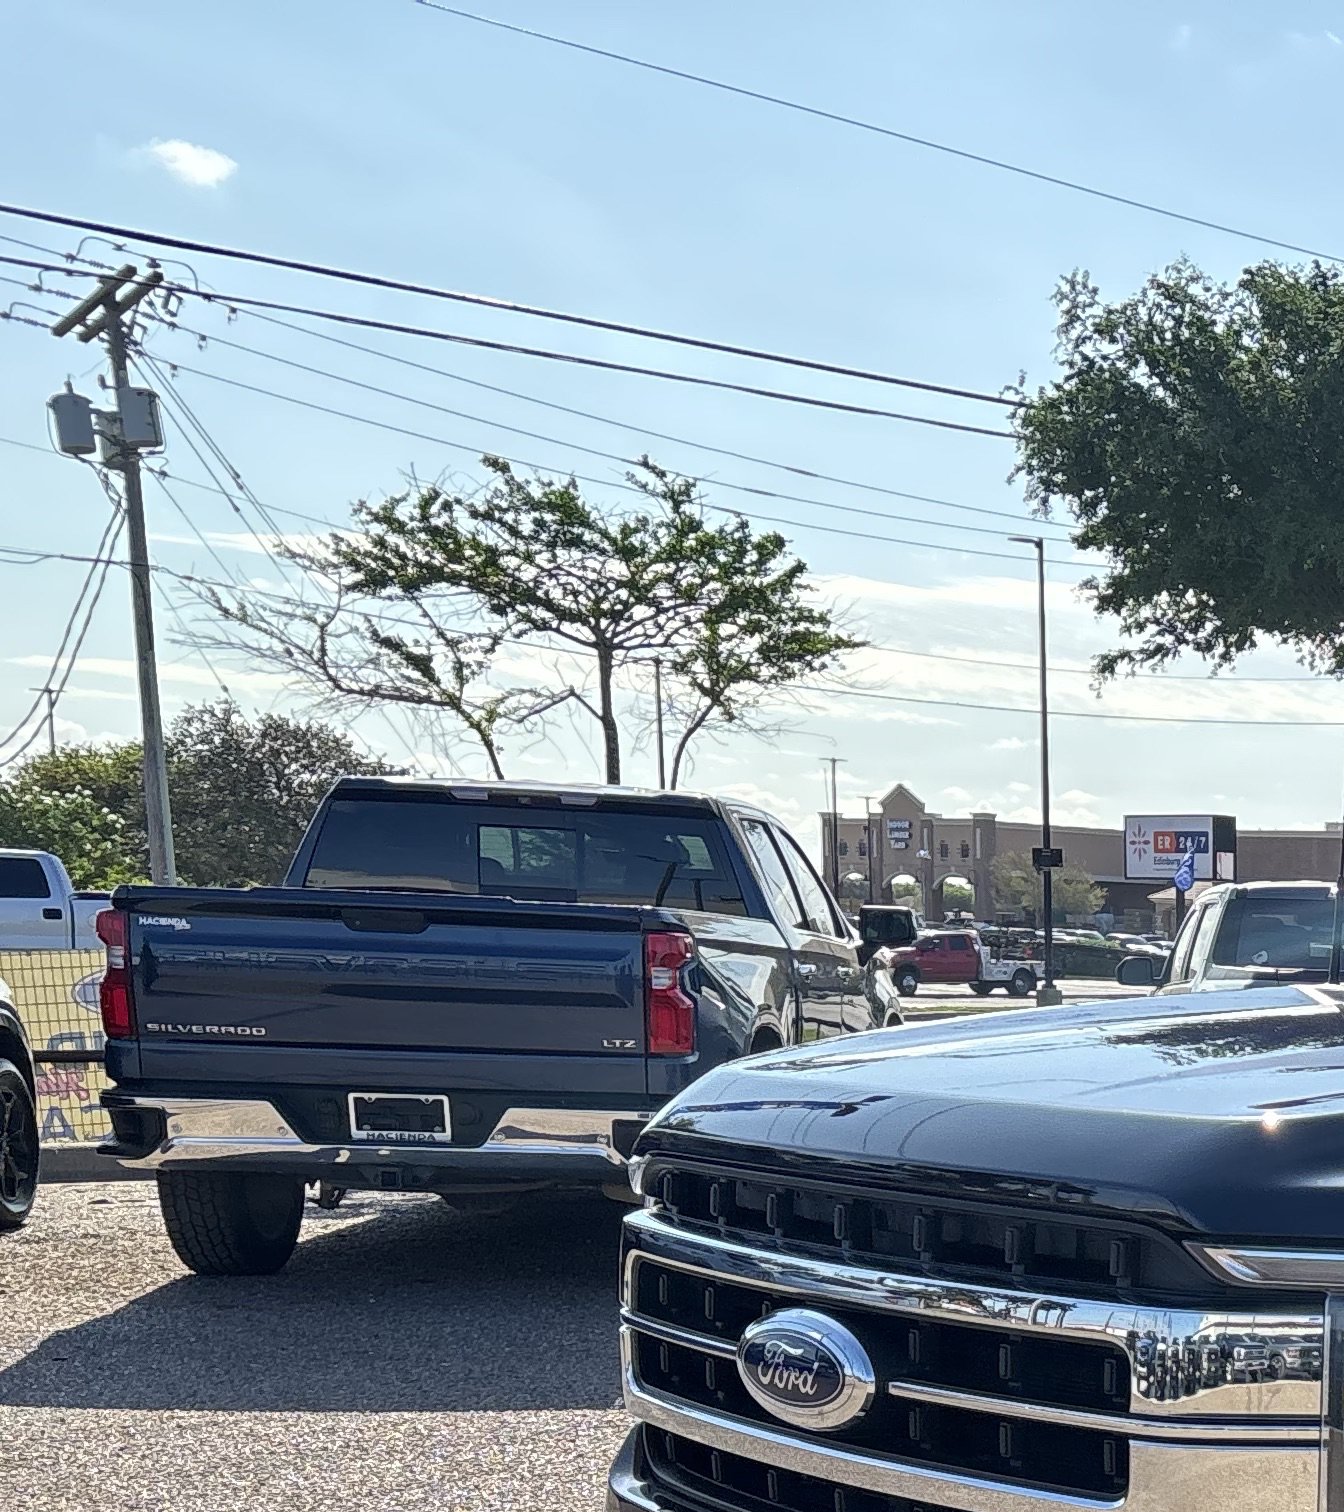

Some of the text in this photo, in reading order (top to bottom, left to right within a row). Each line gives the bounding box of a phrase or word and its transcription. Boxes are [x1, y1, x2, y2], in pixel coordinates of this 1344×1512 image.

[1157, 835, 1171, 849] ER
[146, 1023, 266, 1036] SILVERADO
[602, 1038, 637, 1048] LTZ
[757, 1340, 819, 1396] Ford
